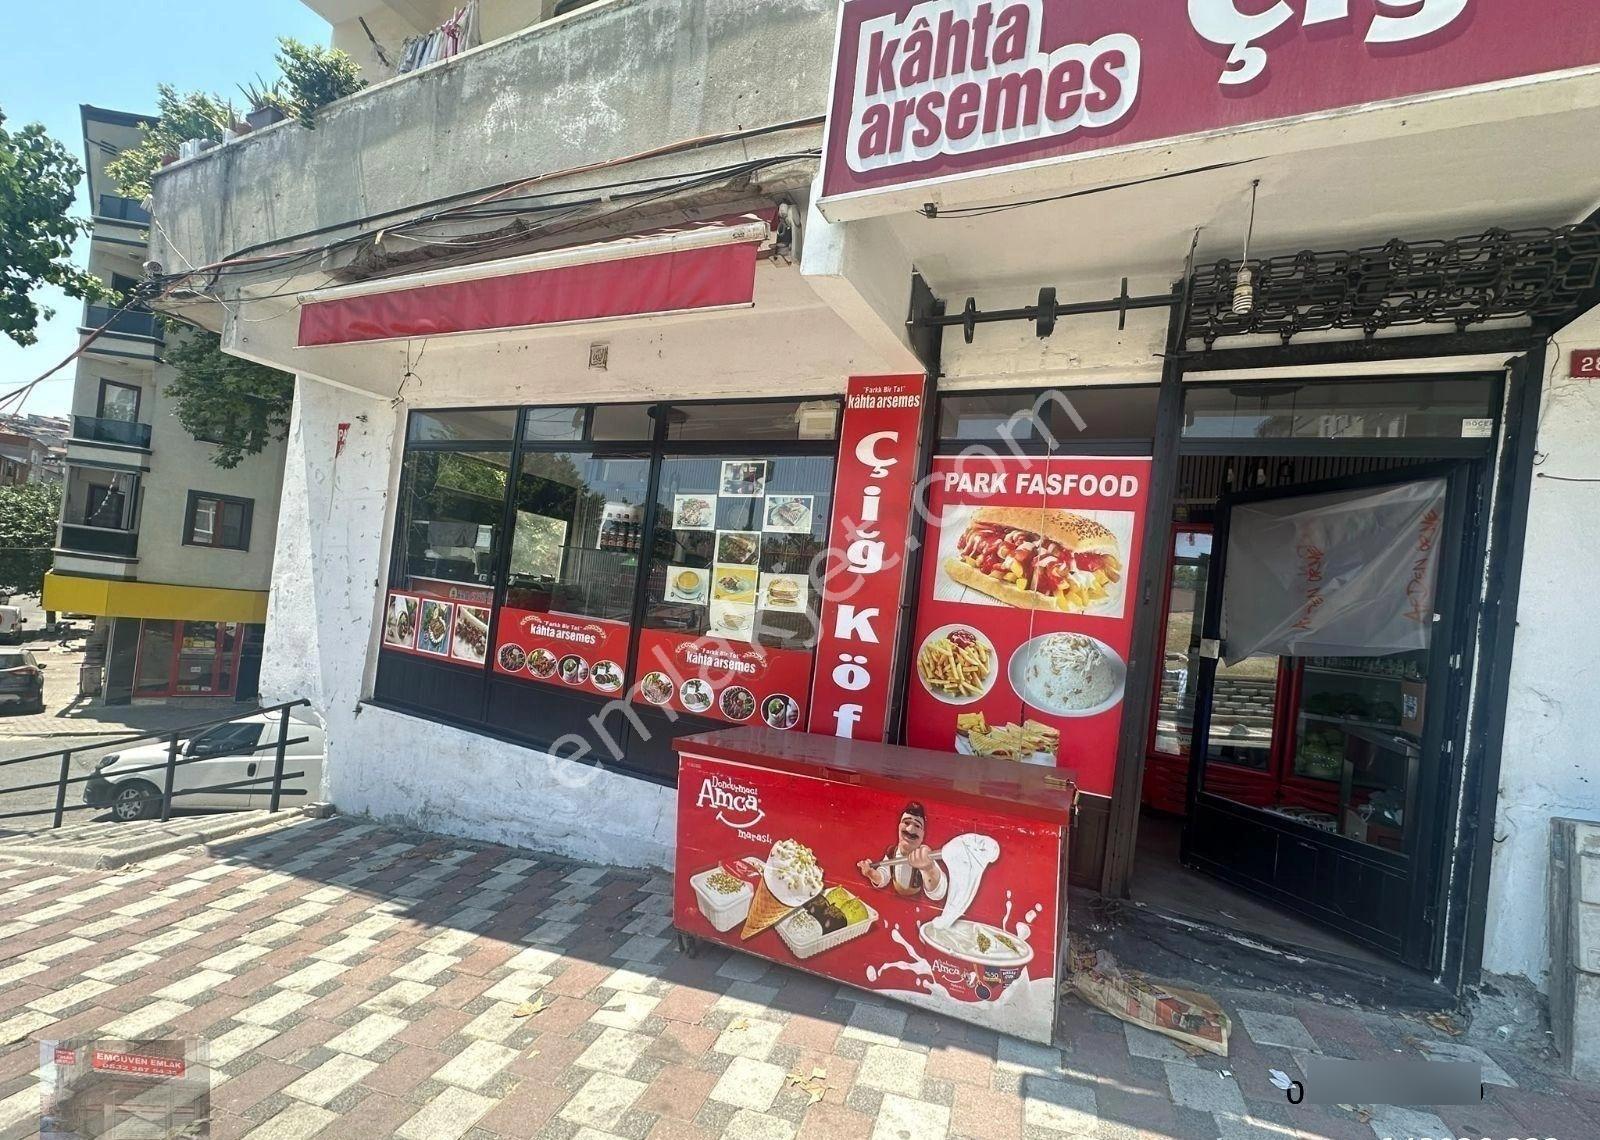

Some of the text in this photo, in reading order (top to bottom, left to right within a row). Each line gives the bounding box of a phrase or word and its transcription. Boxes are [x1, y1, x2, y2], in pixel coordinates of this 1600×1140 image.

[865, 0, 1027, 97] kâhta
[857, 46, 1126, 159] arsemes
[876, 394, 920, 409] arsemes
[944, 472, 1139, 498] PARK FASFOOD
[556, 629, 596, 645] arsemes
[713, 656, 756, 674] arsemes
[696, 778, 758, 812] Amca
